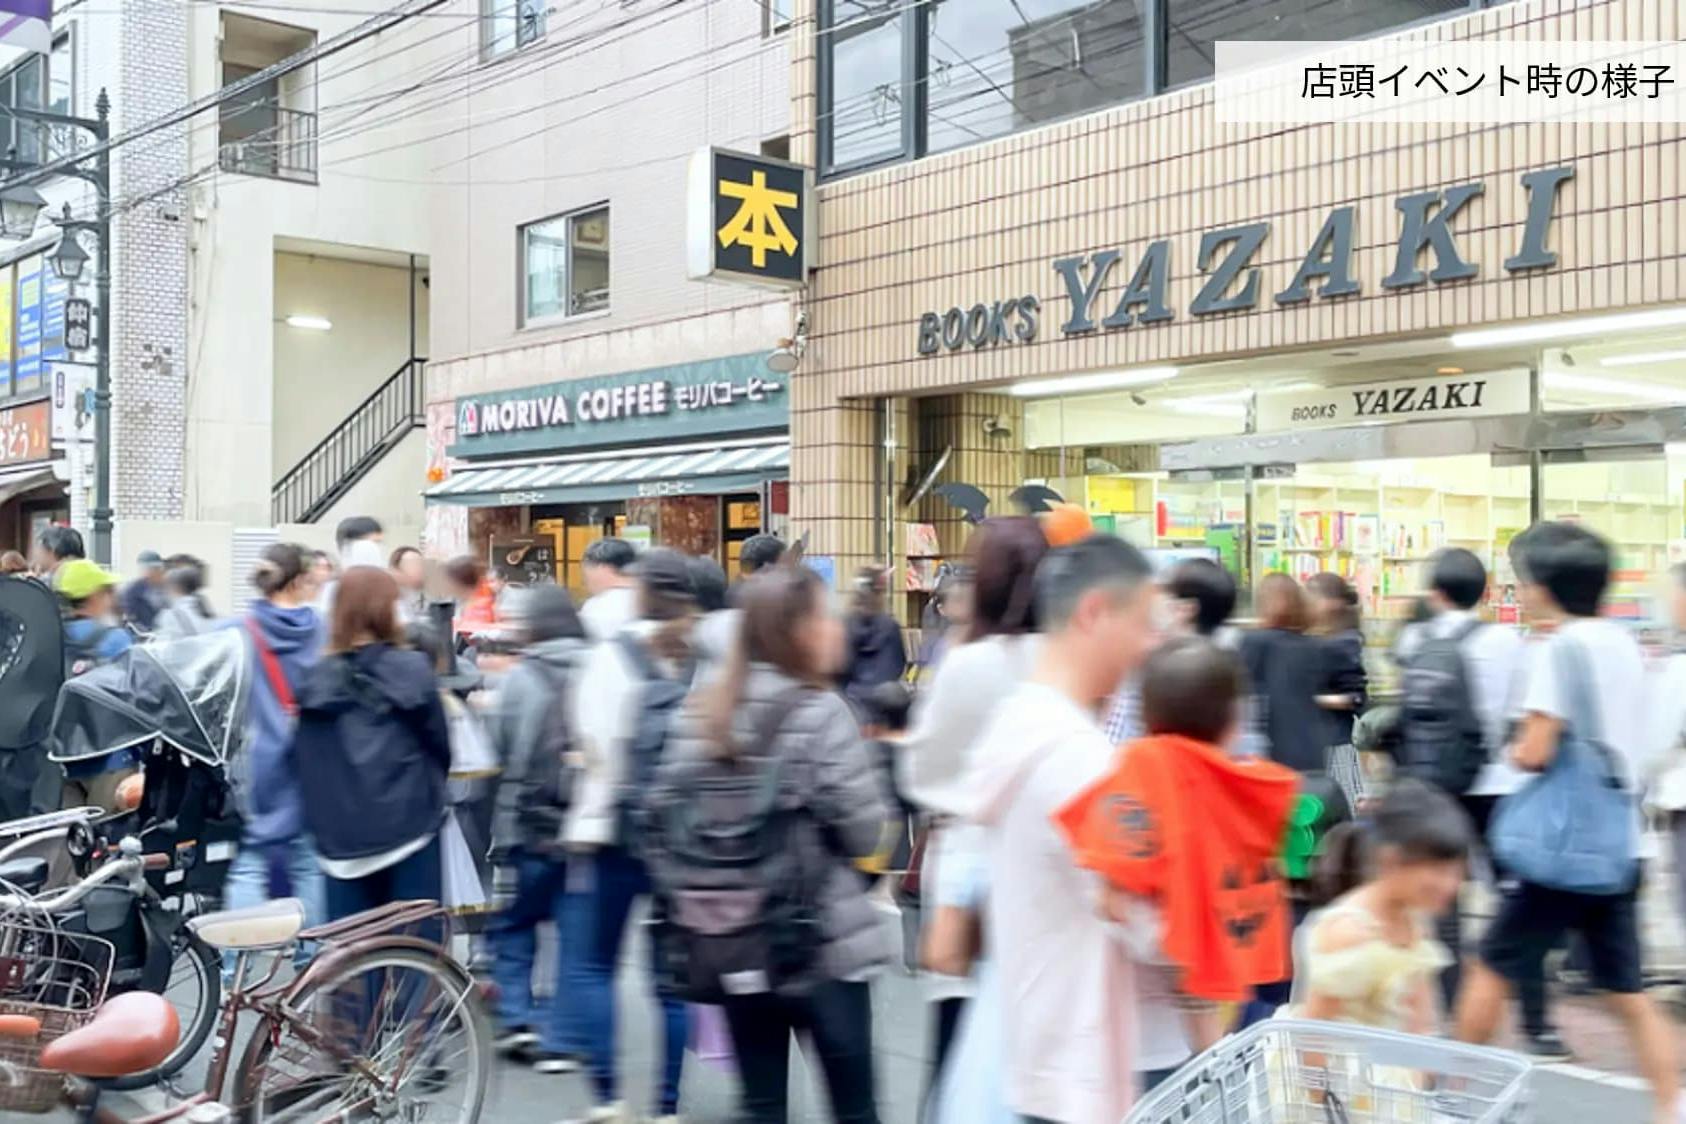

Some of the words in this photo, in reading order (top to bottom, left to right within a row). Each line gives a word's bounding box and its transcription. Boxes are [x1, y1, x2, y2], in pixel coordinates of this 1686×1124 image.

[718, 170, 799, 268] 本
[918, 294, 1041, 355] BOOKS
[1052, 166, 1576, 335] YAZAKI
[481, 395, 569, 432] MORIVA
[577, 381, 666, 421] COFFEE
[1291, 403, 1338, 422] BOOKS
[1352, 380, 1487, 416] YAZAKI
